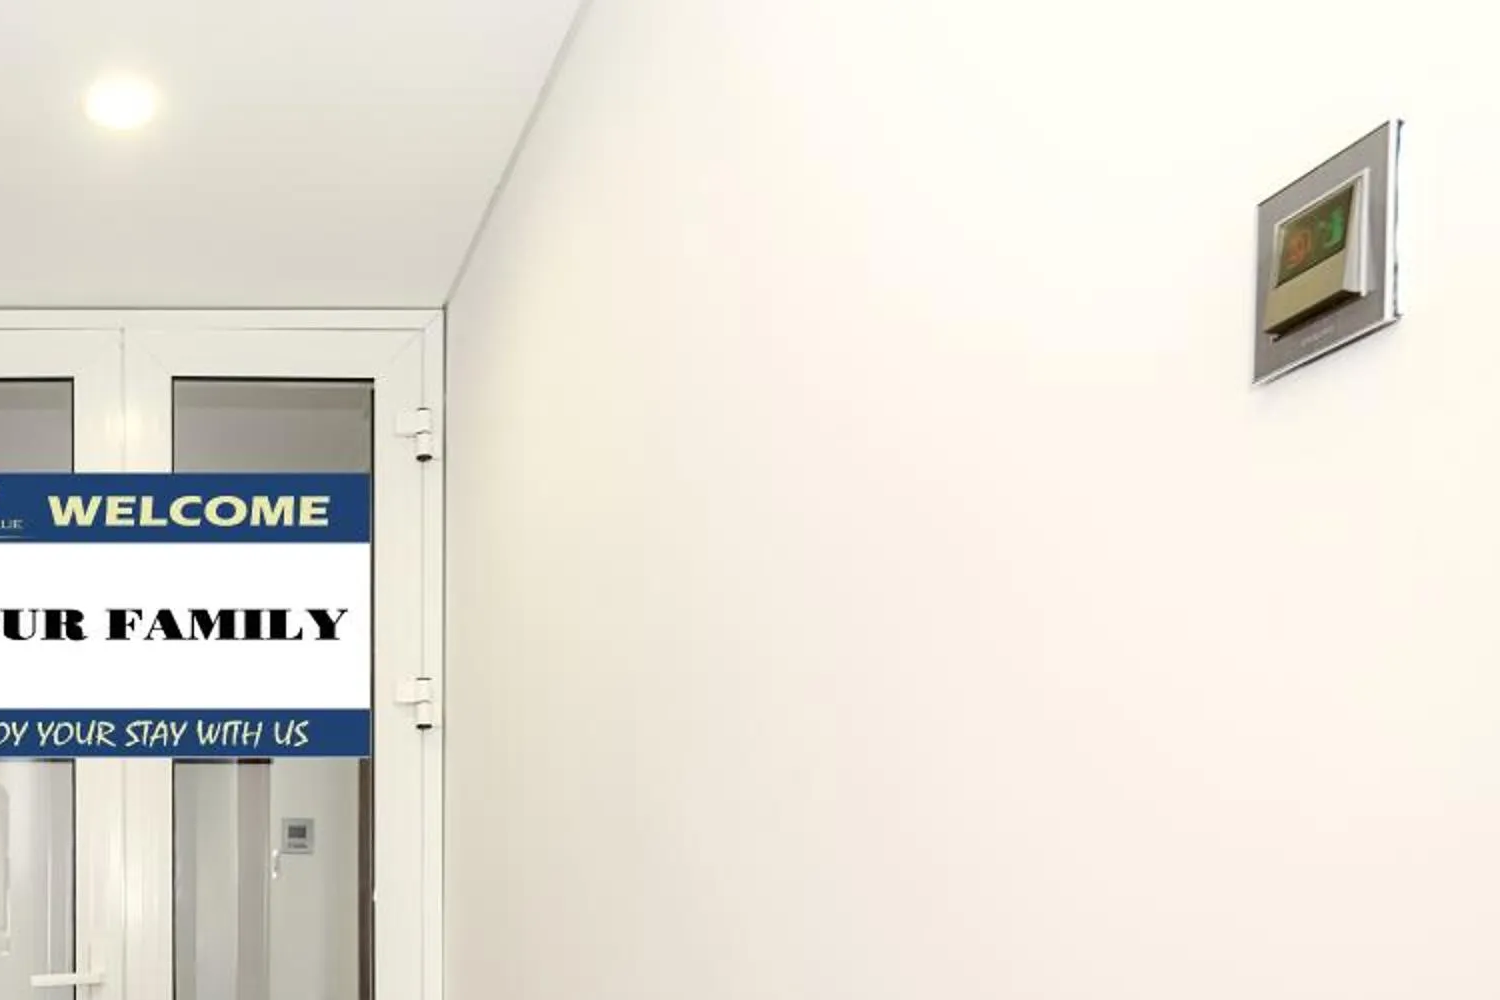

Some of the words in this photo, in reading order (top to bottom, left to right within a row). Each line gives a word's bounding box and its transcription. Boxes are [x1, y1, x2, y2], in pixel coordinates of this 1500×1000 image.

[48, 495, 331, 527] WELCOME
[105, 608, 348, 641] FAMILY
[36, 720, 117, 748] YOUR
[125, 720, 188, 748] STAY
[196, 720, 261, 748] WITH
[273, 720, 309, 747] US
